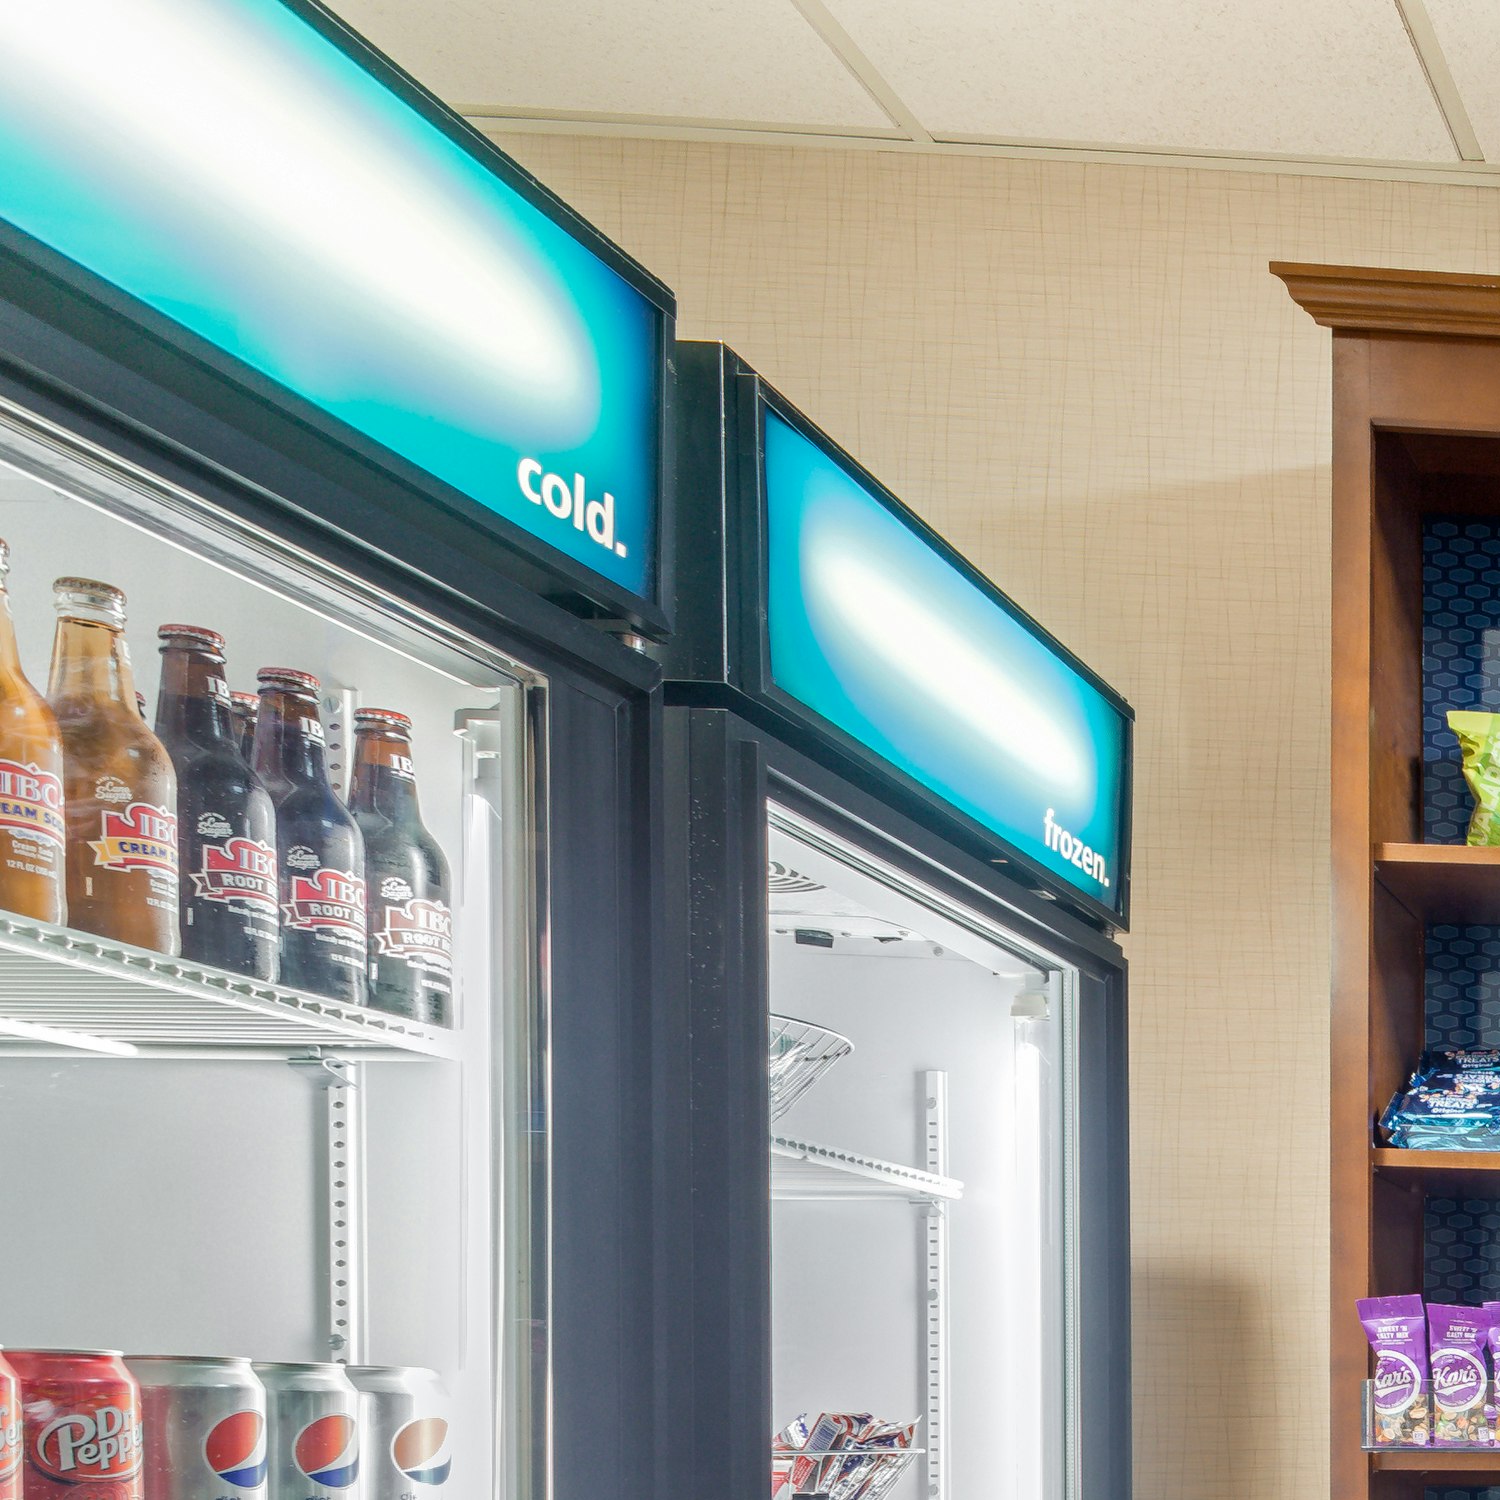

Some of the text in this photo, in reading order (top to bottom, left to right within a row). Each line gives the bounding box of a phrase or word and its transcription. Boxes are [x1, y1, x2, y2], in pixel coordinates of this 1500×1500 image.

[517, 457, 627, 559] cold.
[117, 841, 168, 860] CREAM
[1044, 807, 1110, 888] frozen.
[222, 873, 264, 892] ROOT
[310, 904, 350, 920] ROOT
[1432, 1361, 1478, 1389] Kar's
[98, 1406, 134, 1437] Dr
